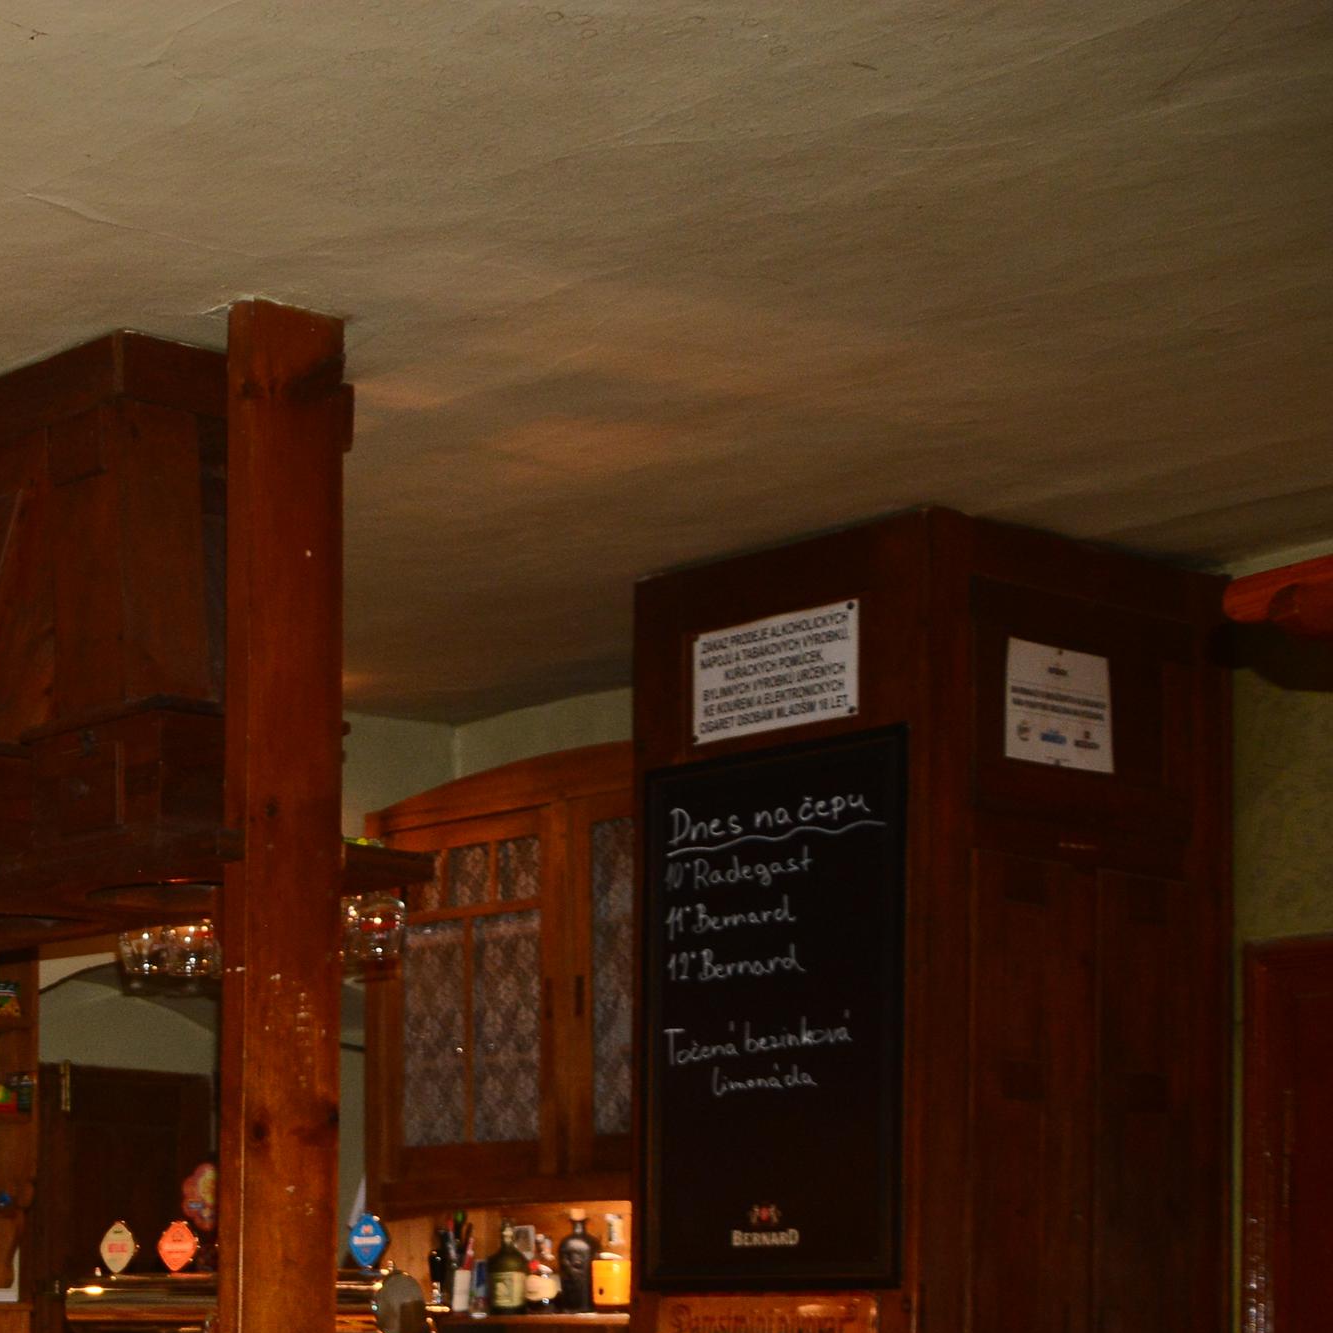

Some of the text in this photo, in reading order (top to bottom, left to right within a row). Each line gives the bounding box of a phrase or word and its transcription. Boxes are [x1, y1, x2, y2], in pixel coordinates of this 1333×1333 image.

[731, 628, 769, 645] PRODEJE
[771, 612, 848, 637] ALKOHOLICKÝCH
[701, 717, 733, 733] CIGARET
[668, 794, 871, 846] Dnes na čepu
[692, 845, 813, 889] Radegast
[692, 893, 797, 933] Bernard
[697, 942, 807, 981] Bernard
[731, 1228, 800, 1247] BERNARD
